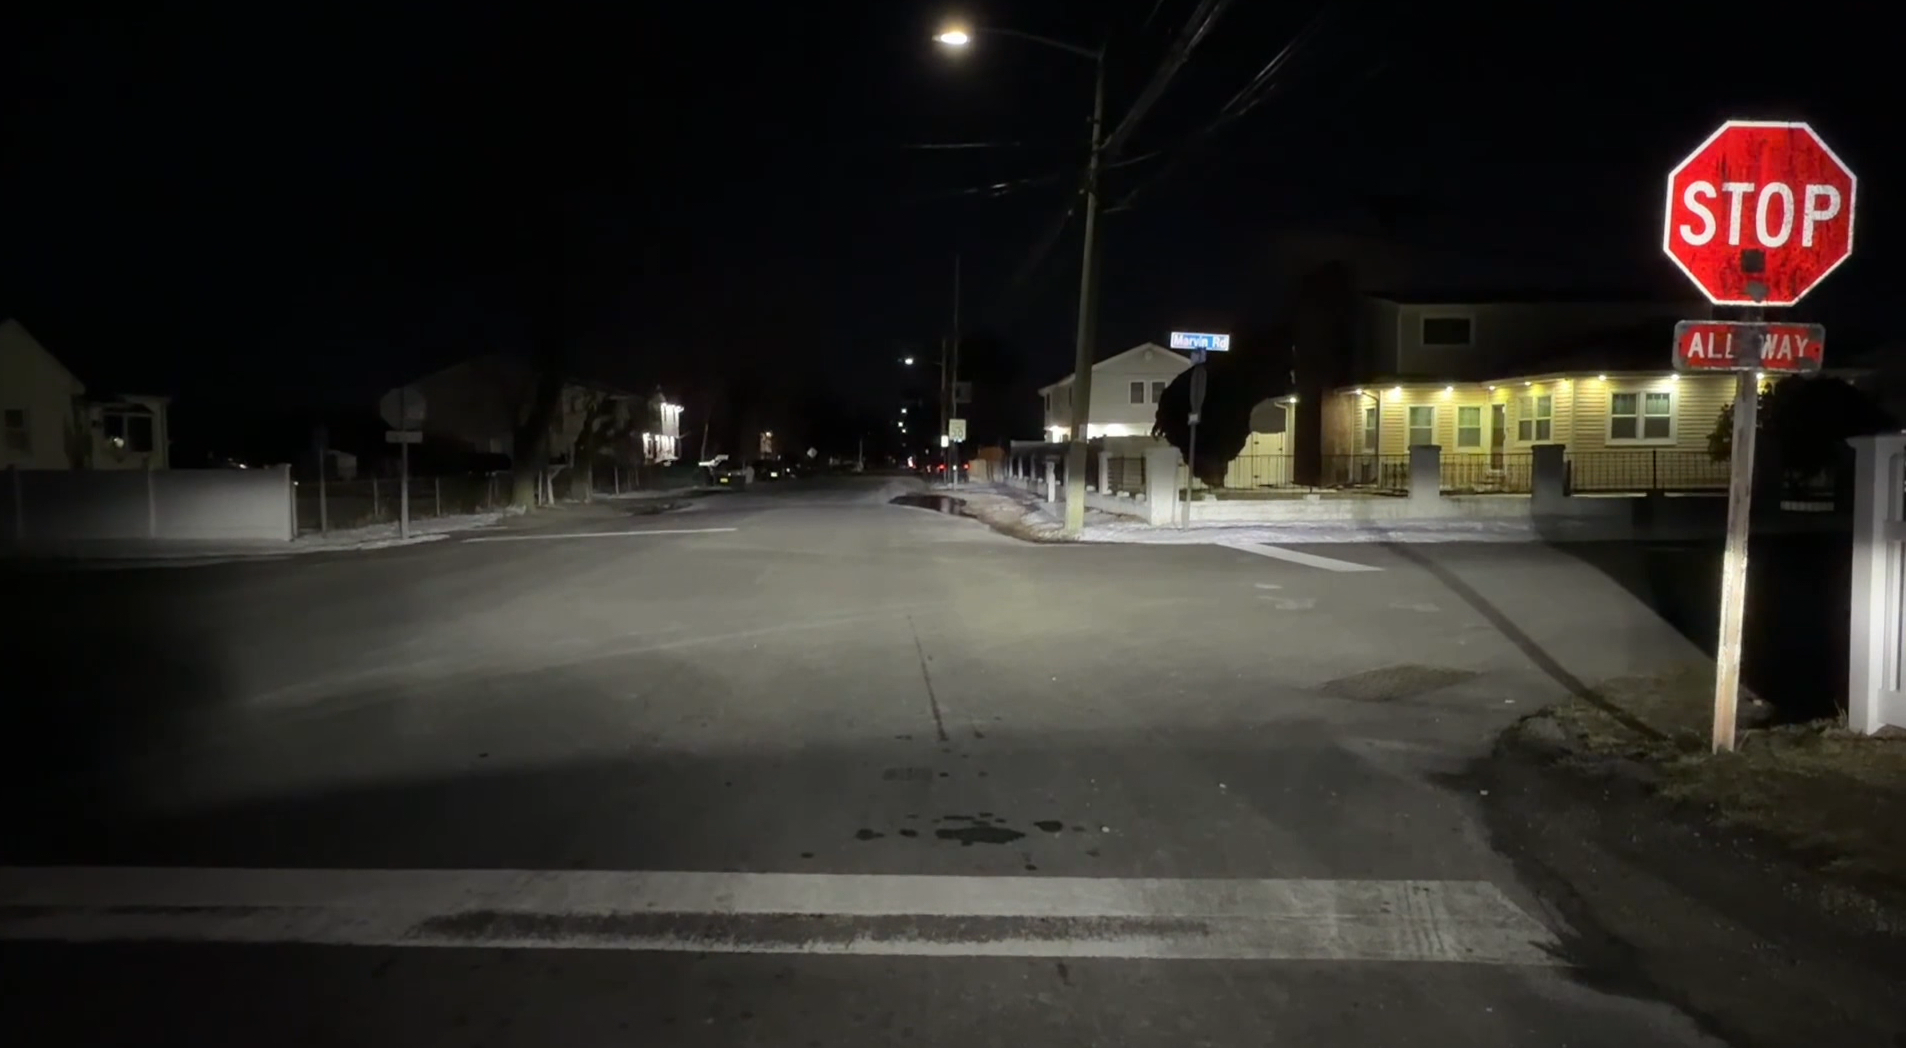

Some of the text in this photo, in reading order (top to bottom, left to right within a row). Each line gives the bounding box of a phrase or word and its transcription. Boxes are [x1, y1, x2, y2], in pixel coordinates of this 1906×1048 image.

[1679, 180, 1841, 248] STOP
[1173, 334, 1227, 348] Marvin Rd
[1687, 332, 1809, 360] ALL WAY
